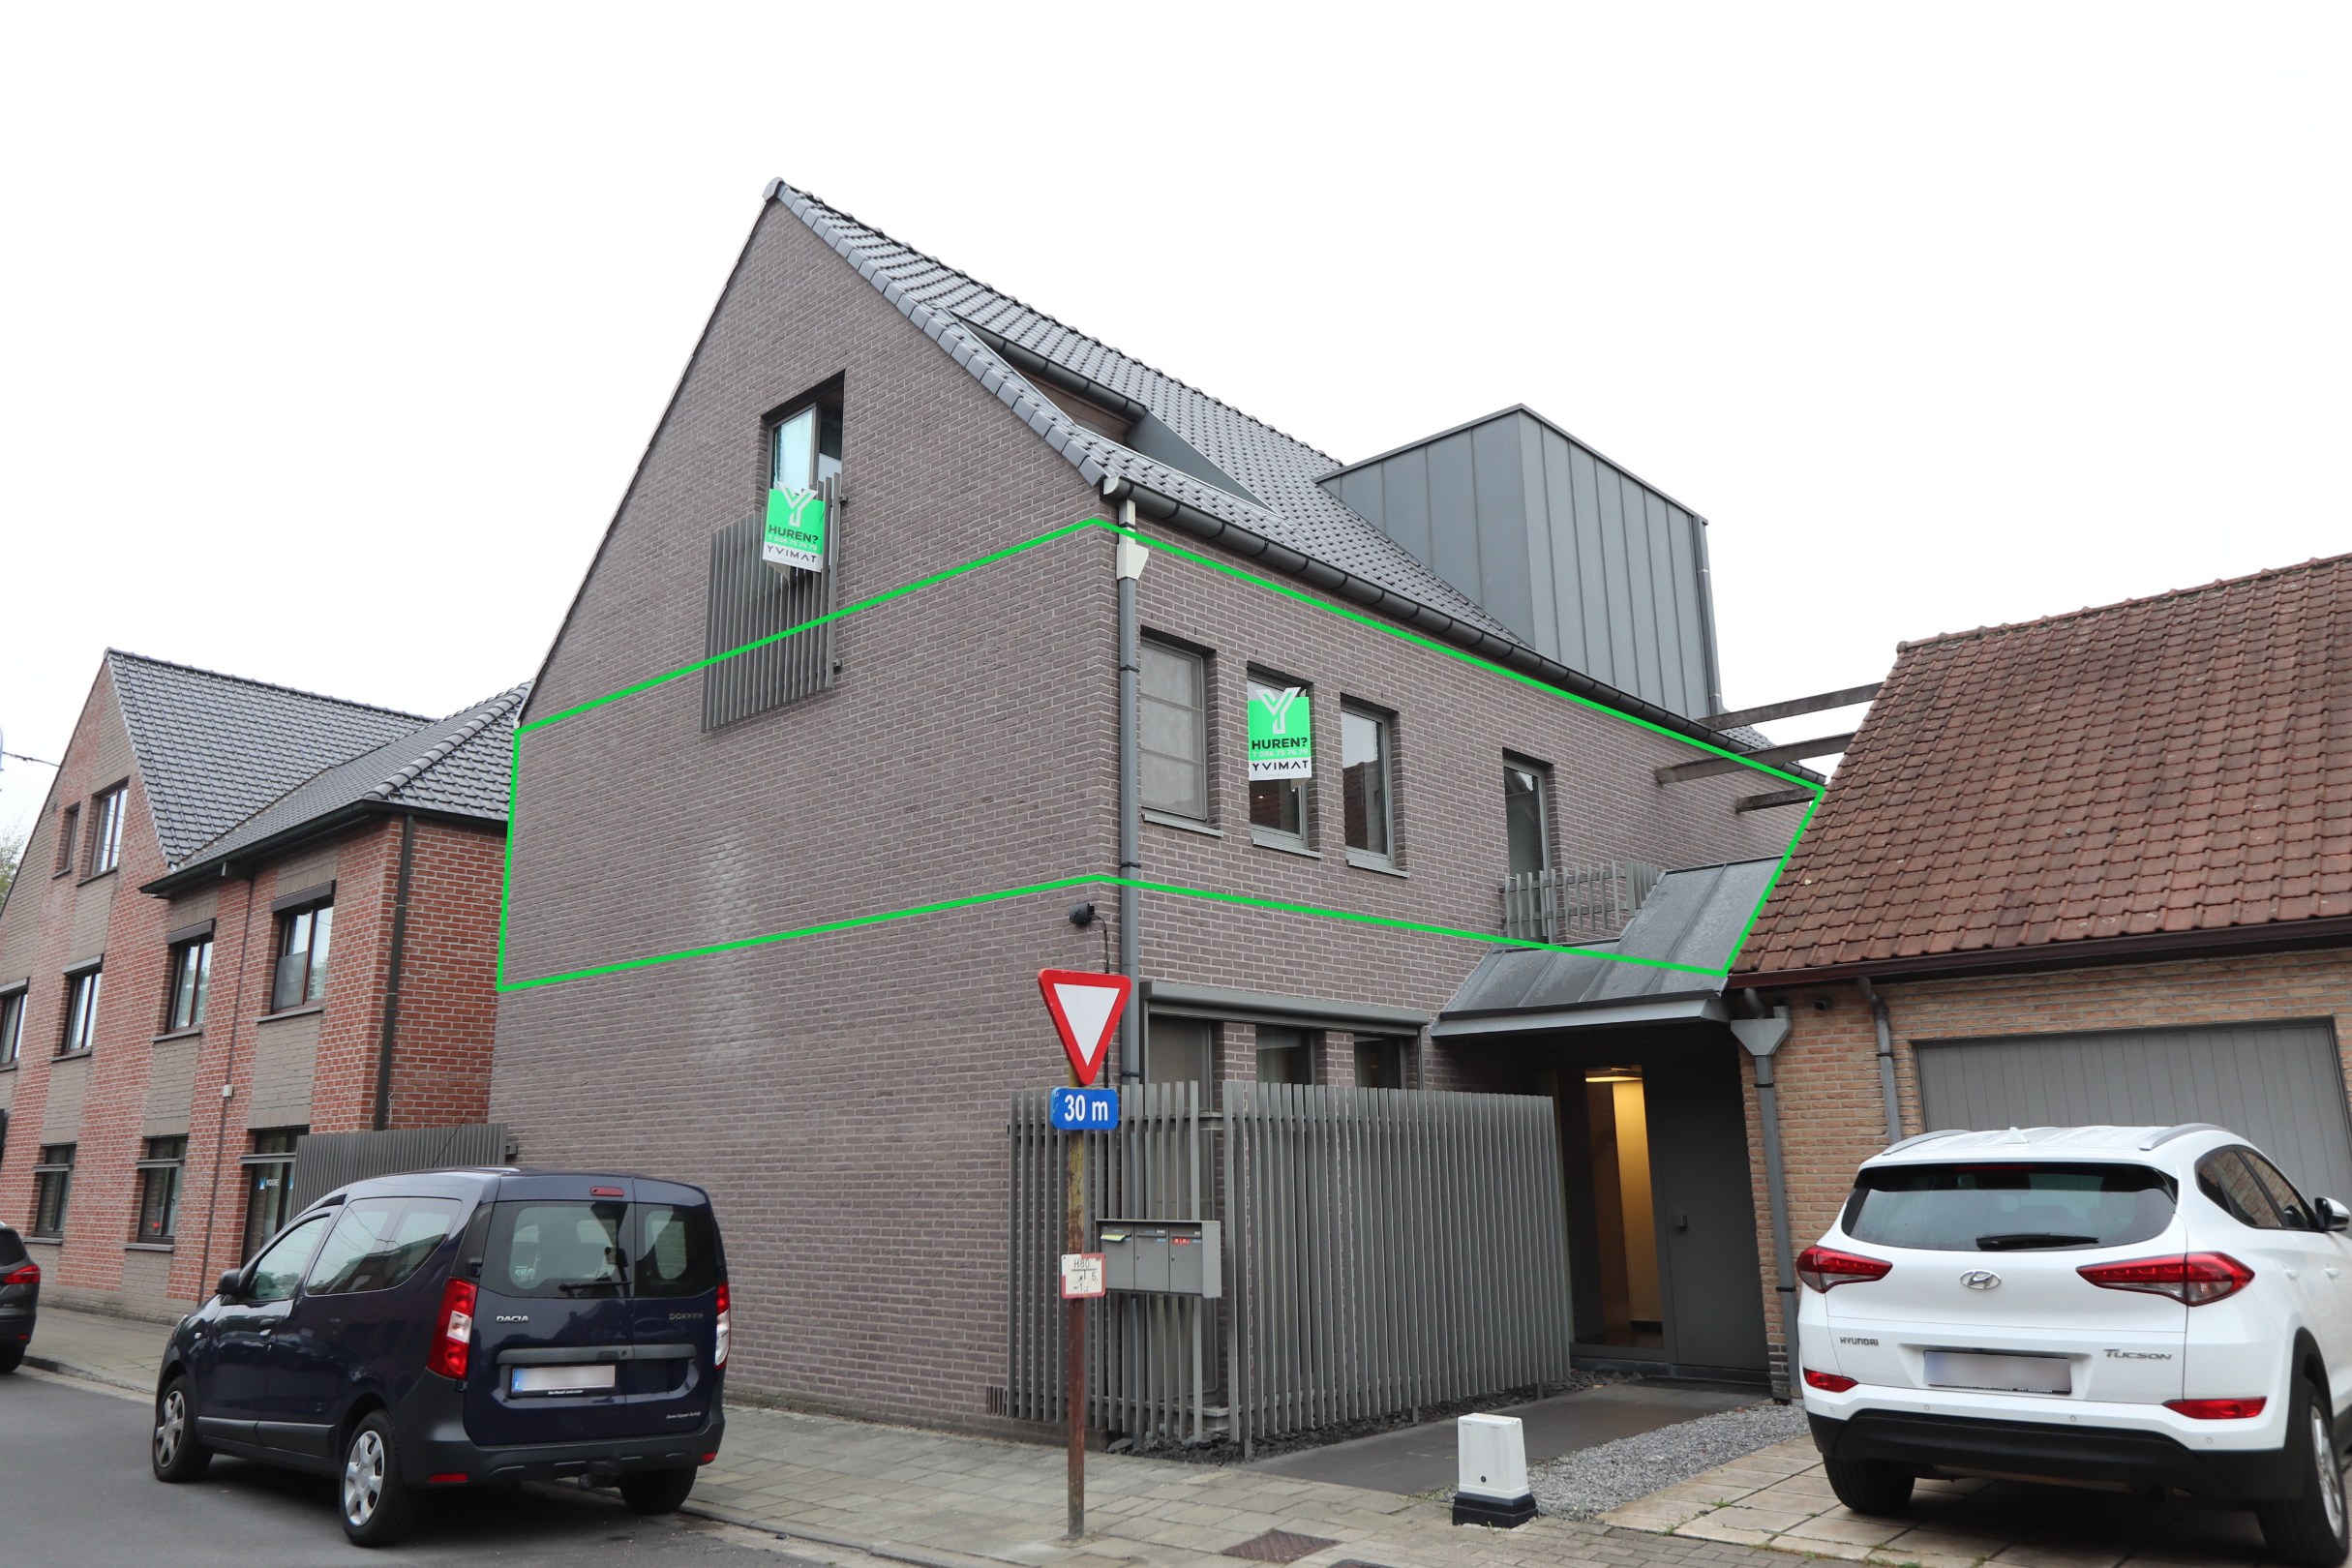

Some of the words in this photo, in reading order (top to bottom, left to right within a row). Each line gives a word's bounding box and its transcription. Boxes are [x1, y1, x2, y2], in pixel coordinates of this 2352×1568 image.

[769, 525, 819, 544] HUREN?
[767, 545, 817, 563] YVIMAT
[1251, 737, 1308, 750] HUREN?
[1251, 760, 1309, 771] YVIMAT
[1064, 1094, 1086, 1122] 30
[1092, 1101, 1108, 1122] m
[1073, 1257, 1090, 1269] H80
[1839, 1336, 1880, 1346] HYUNDAI
[2102, 1348, 2173, 1360] TUCSON
